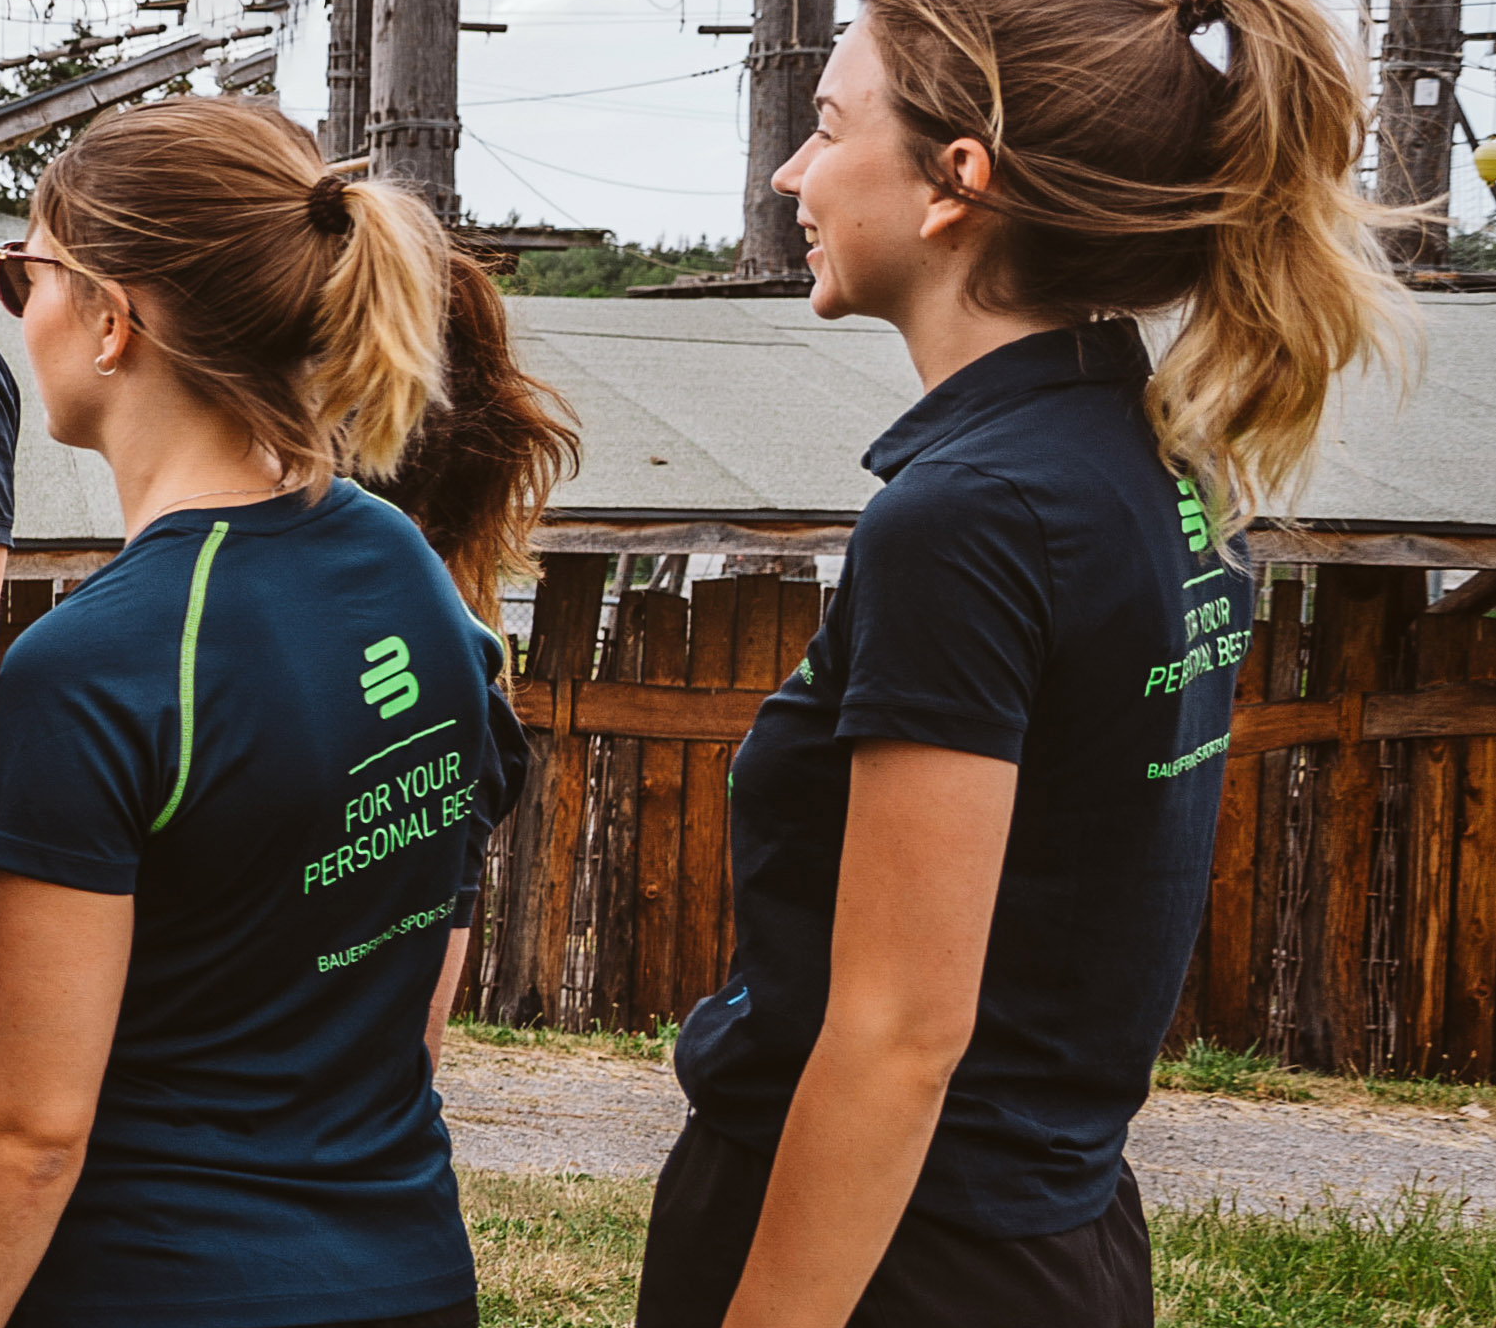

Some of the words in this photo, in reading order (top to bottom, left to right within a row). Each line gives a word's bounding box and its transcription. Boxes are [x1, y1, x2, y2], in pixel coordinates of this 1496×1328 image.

[345, 783, 392, 833] FOR
[396, 751, 461, 804] YOUR
[304, 807, 438, 895] PERSONAL
